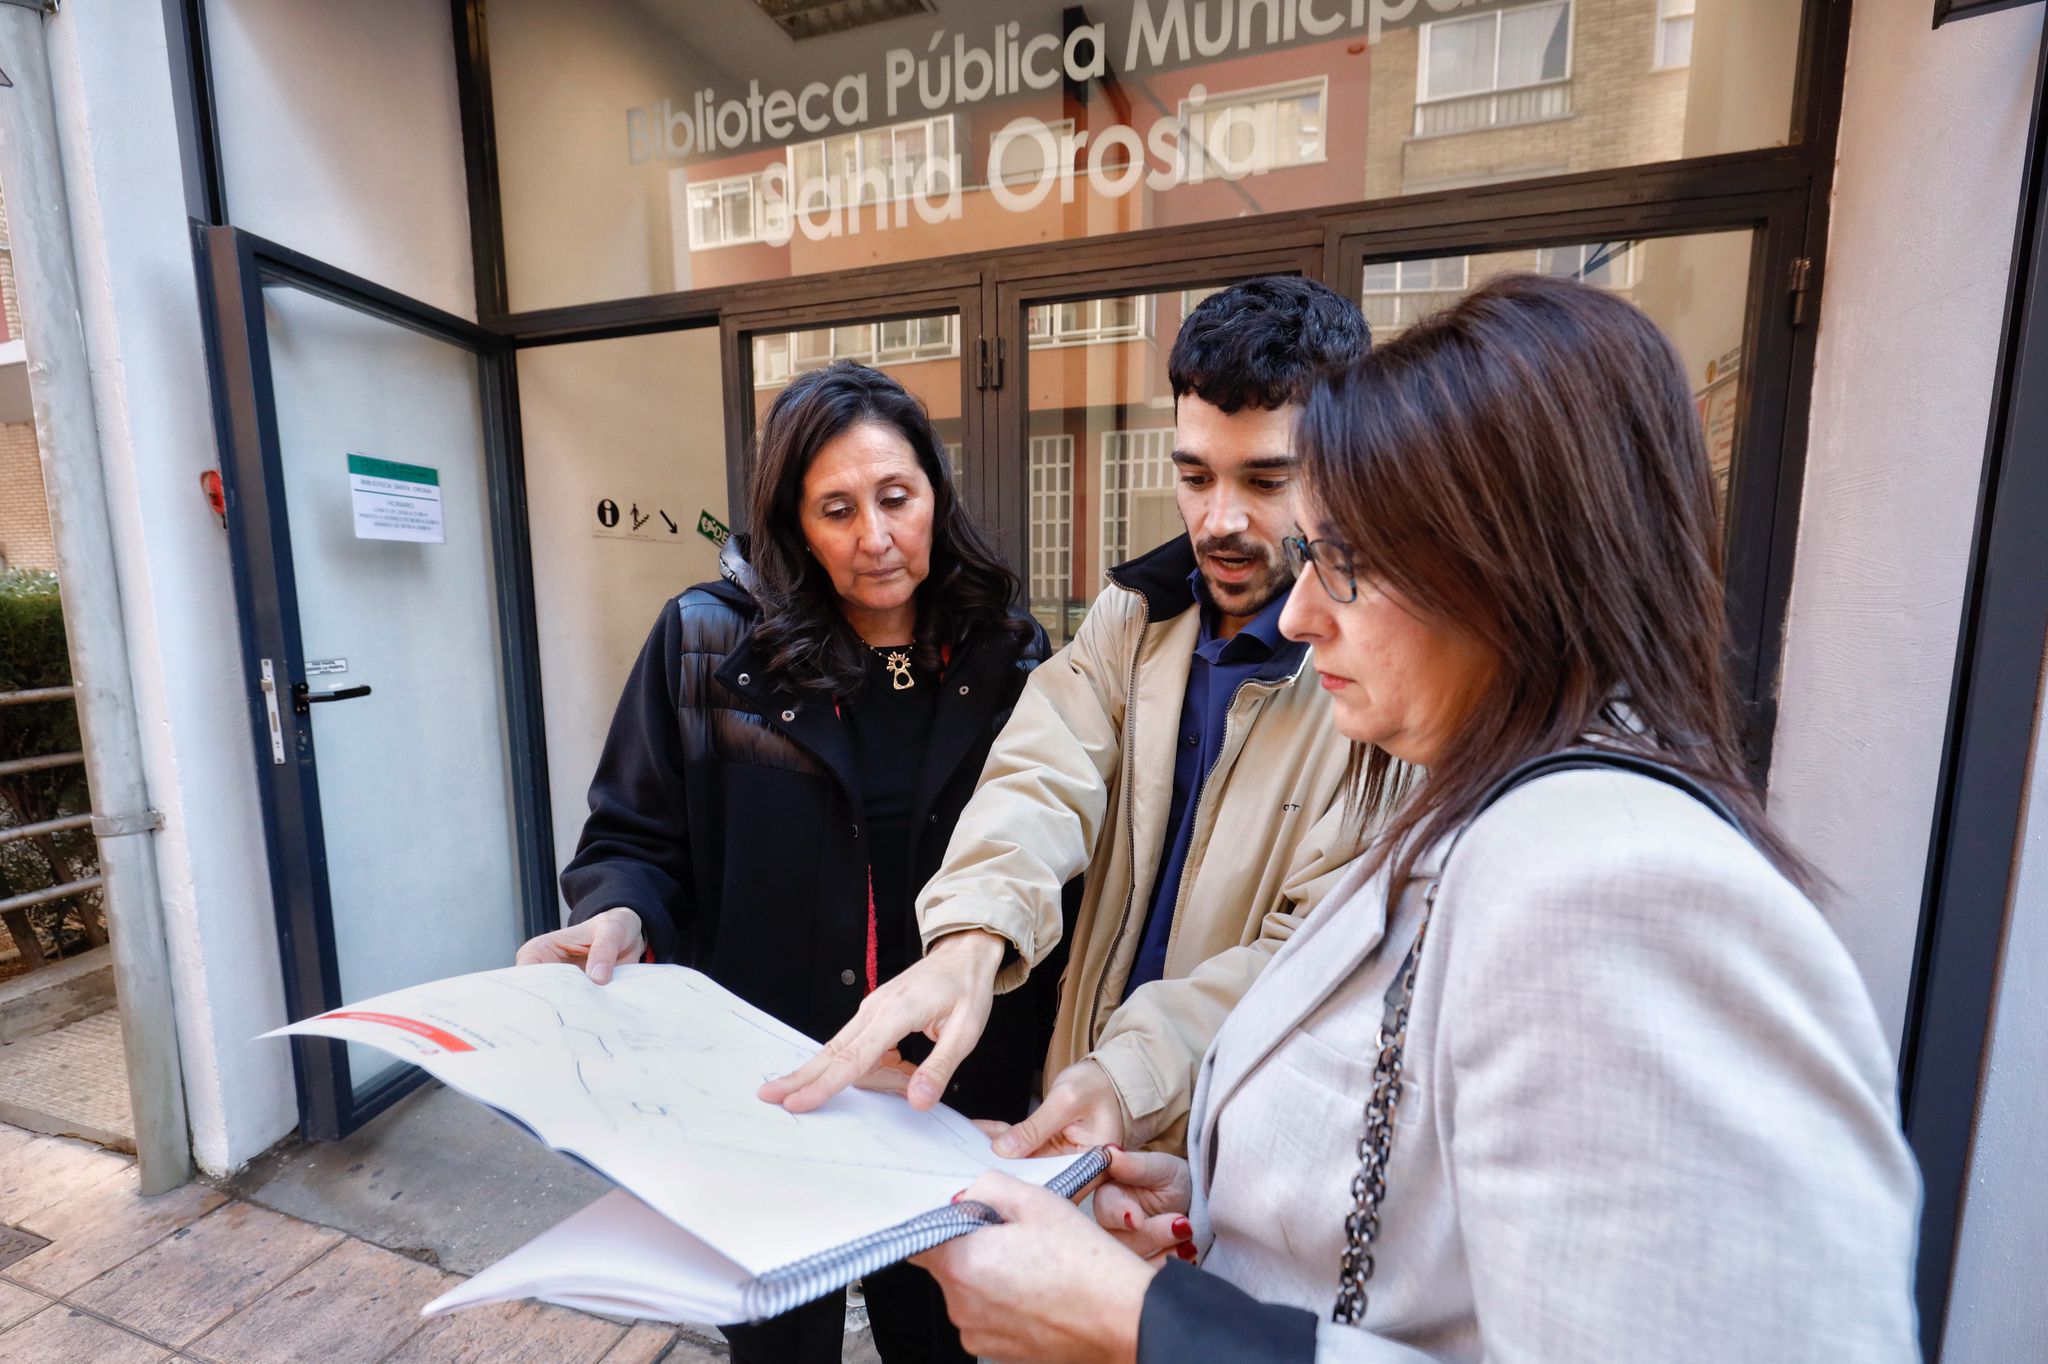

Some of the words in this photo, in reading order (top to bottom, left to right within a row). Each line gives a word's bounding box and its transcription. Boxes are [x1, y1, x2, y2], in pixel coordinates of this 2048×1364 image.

[627, 73, 867, 165] Biblioteca
[886, 21, 1106, 117] Pública
[1124, 0, 1494, 71] Municp
[759, 142, 963, 247] Santa
[987, 84, 1269, 212] Orosia
